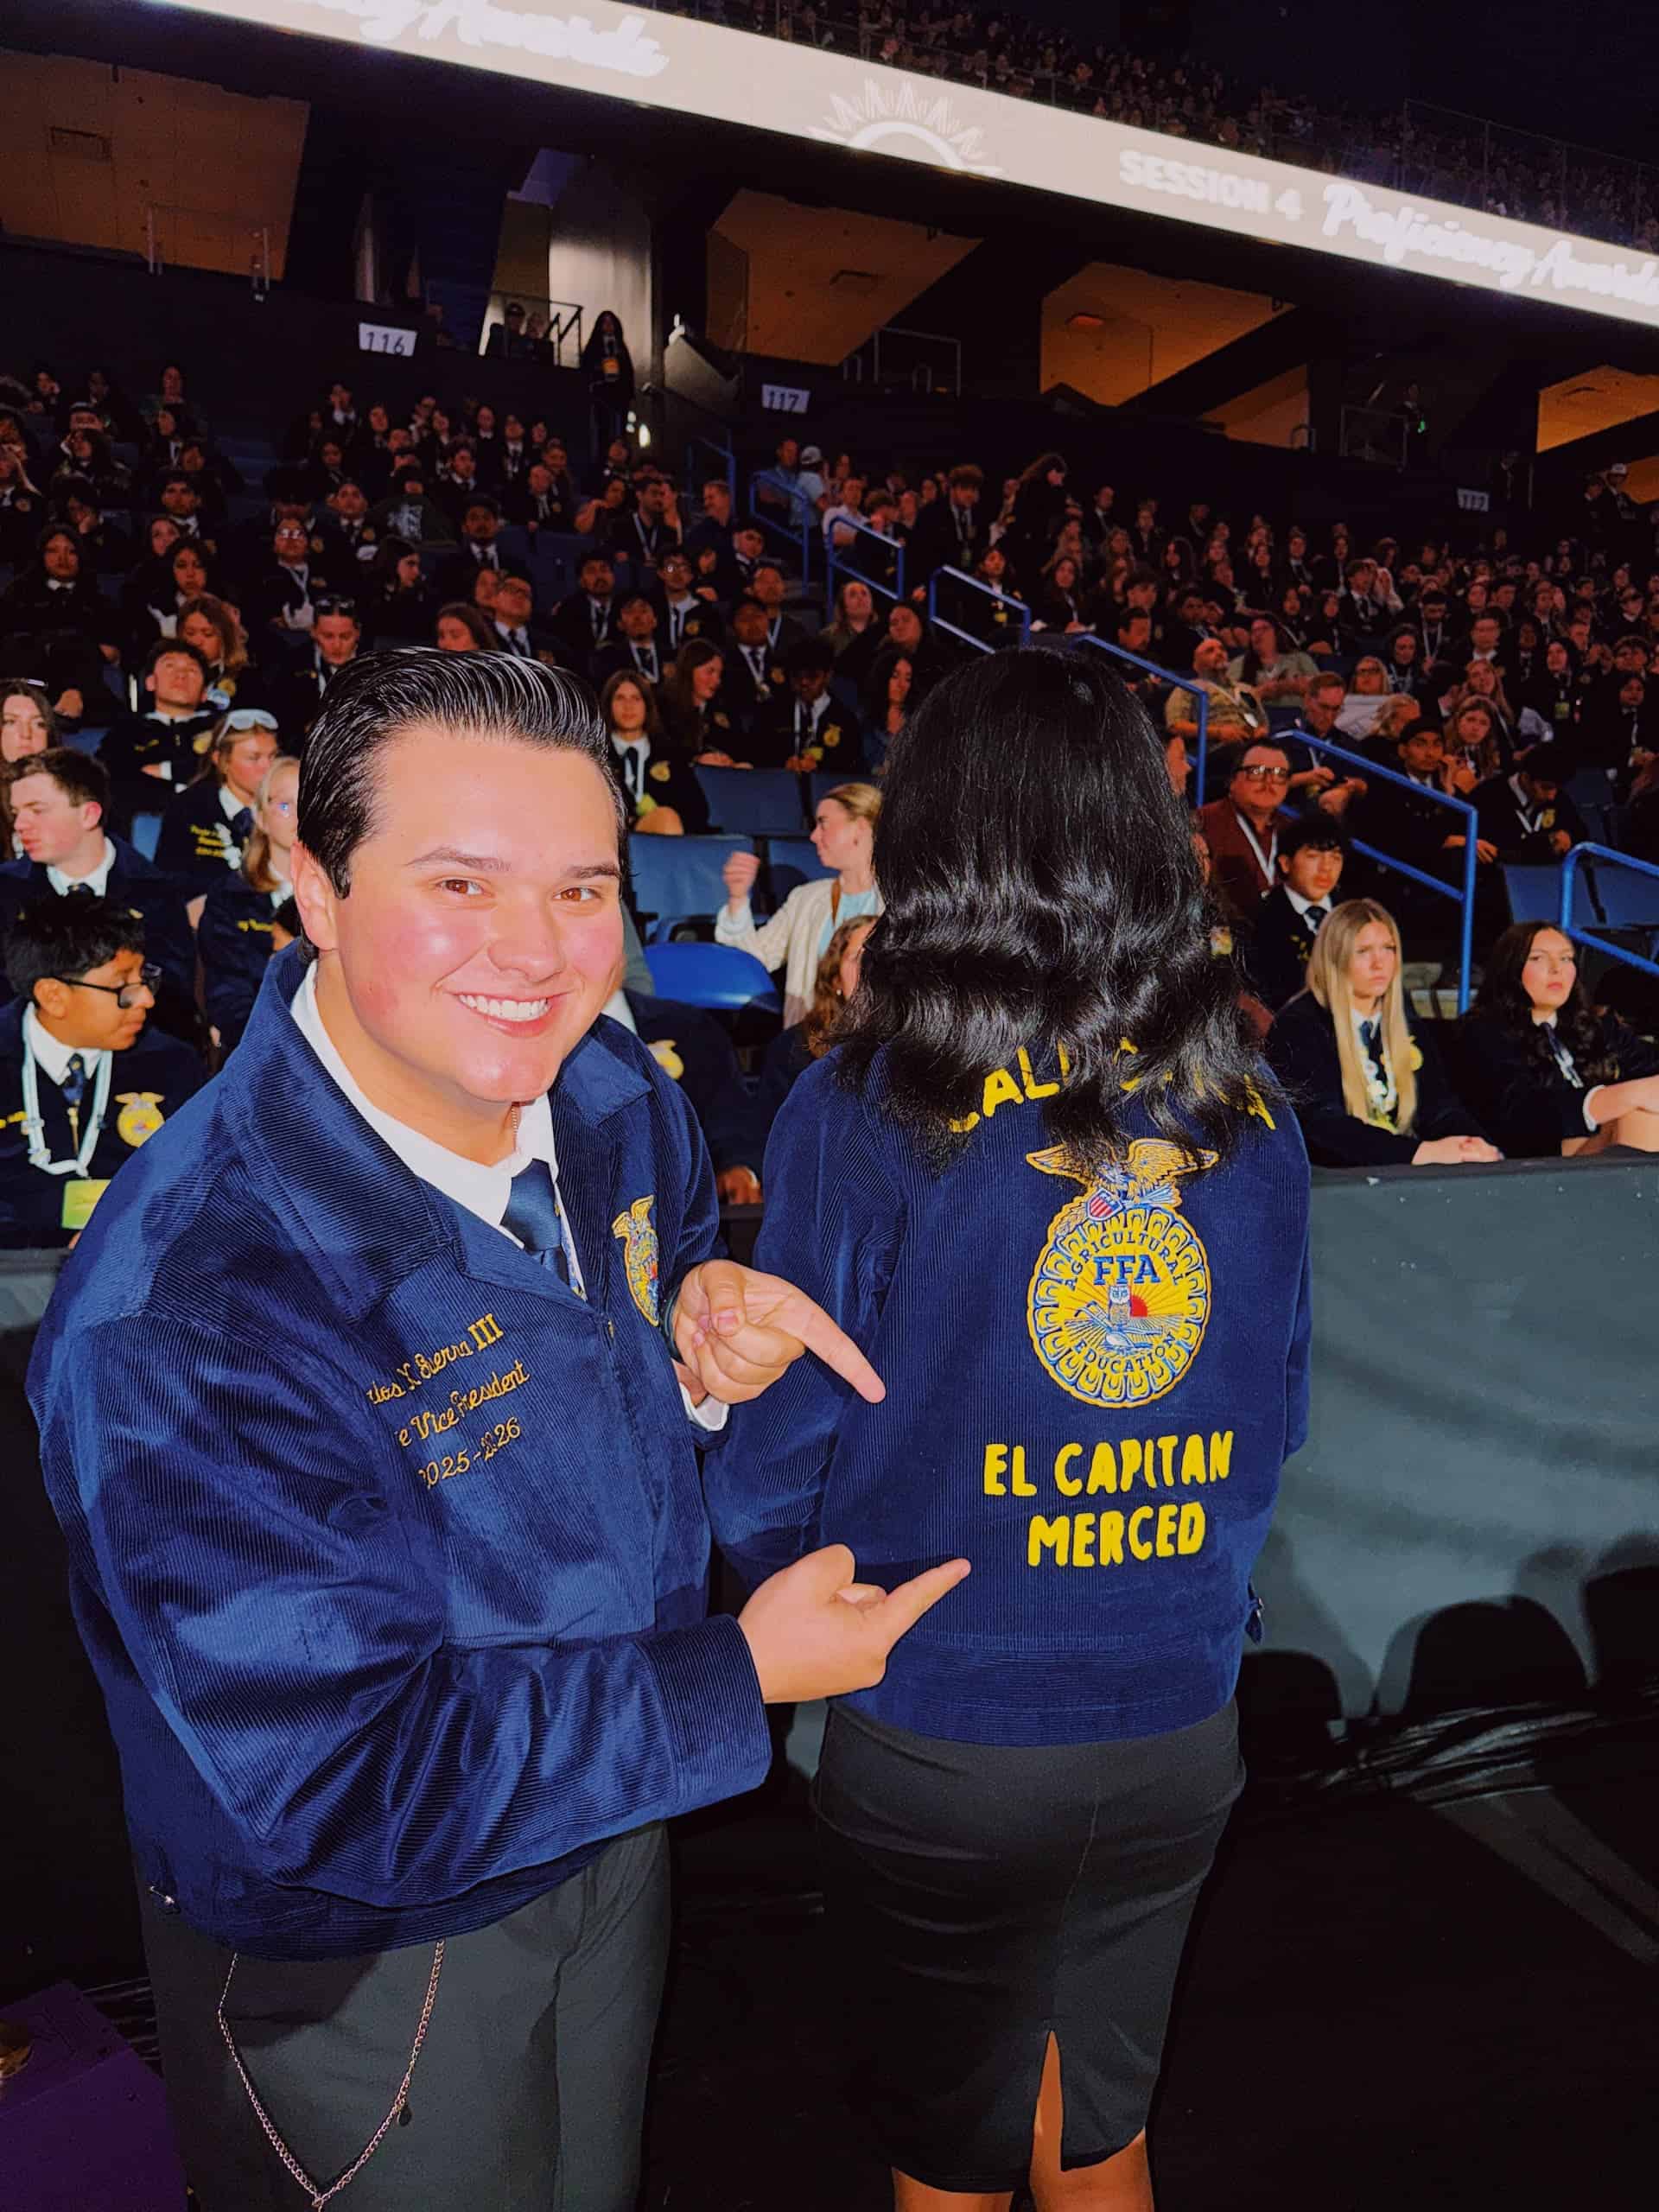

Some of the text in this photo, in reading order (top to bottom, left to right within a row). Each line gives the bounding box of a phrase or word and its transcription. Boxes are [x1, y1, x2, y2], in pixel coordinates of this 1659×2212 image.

[1120, 150, 1659, 305] SESSION 4 Proficiency Award
[365, 331, 404, 355] 116
[768, 391, 800, 412] 117
[1065, 1230, 1185, 1292] AGRICULTURAL
[1093, 1254, 1160, 1286] FFA
[415, 1340, 474, 1379] Sierra
[467, 1313, 504, 1351] III
[1074, 1331, 1176, 1375] EDUCATION
[410, 1408, 459, 1440] Vice
[983, 1430, 1234, 1497] EL CAPITAN
[1027, 1501, 1206, 1567] MERCED
